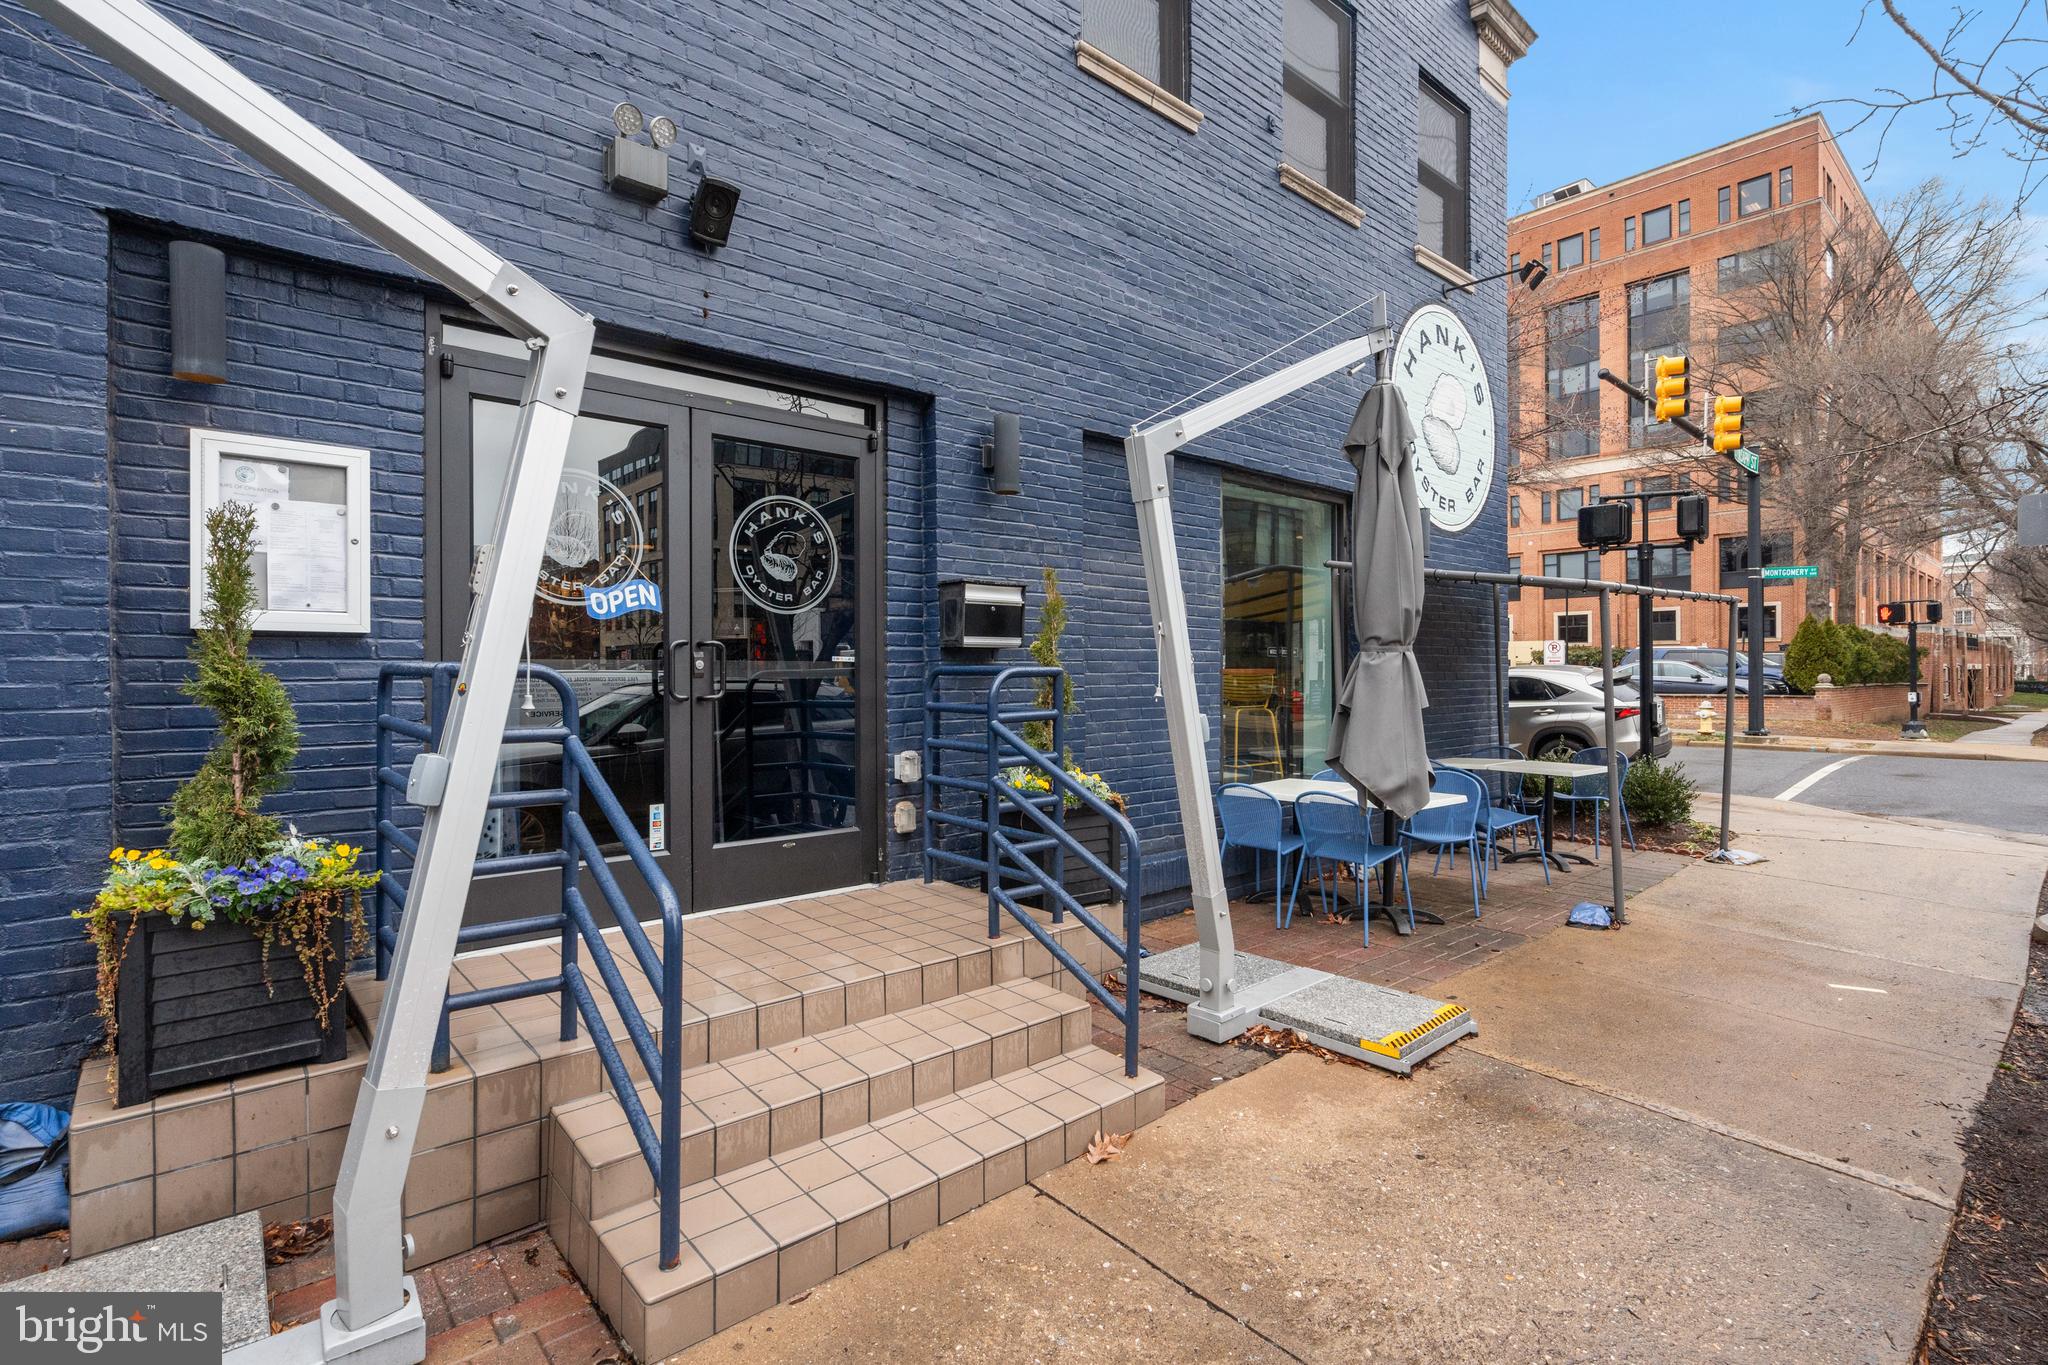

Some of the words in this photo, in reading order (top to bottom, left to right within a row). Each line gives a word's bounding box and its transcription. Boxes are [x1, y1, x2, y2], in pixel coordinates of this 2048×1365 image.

[1403, 324, 1485, 406] HANK'S
[1466, 461, 1485, 504] BAR
[560, 481, 626, 525] NK'S
[744, 507, 825, 545] HANK'S
[538, 569, 586, 591] STER
[599, 554, 626, 585] BAR
[745, 564, 793, 602] OYSTER
[803, 570, 824, 596] BAR
[1764, 568, 1809, 577] MONTGOMERY
[590, 583, 657, 615] OPEN
